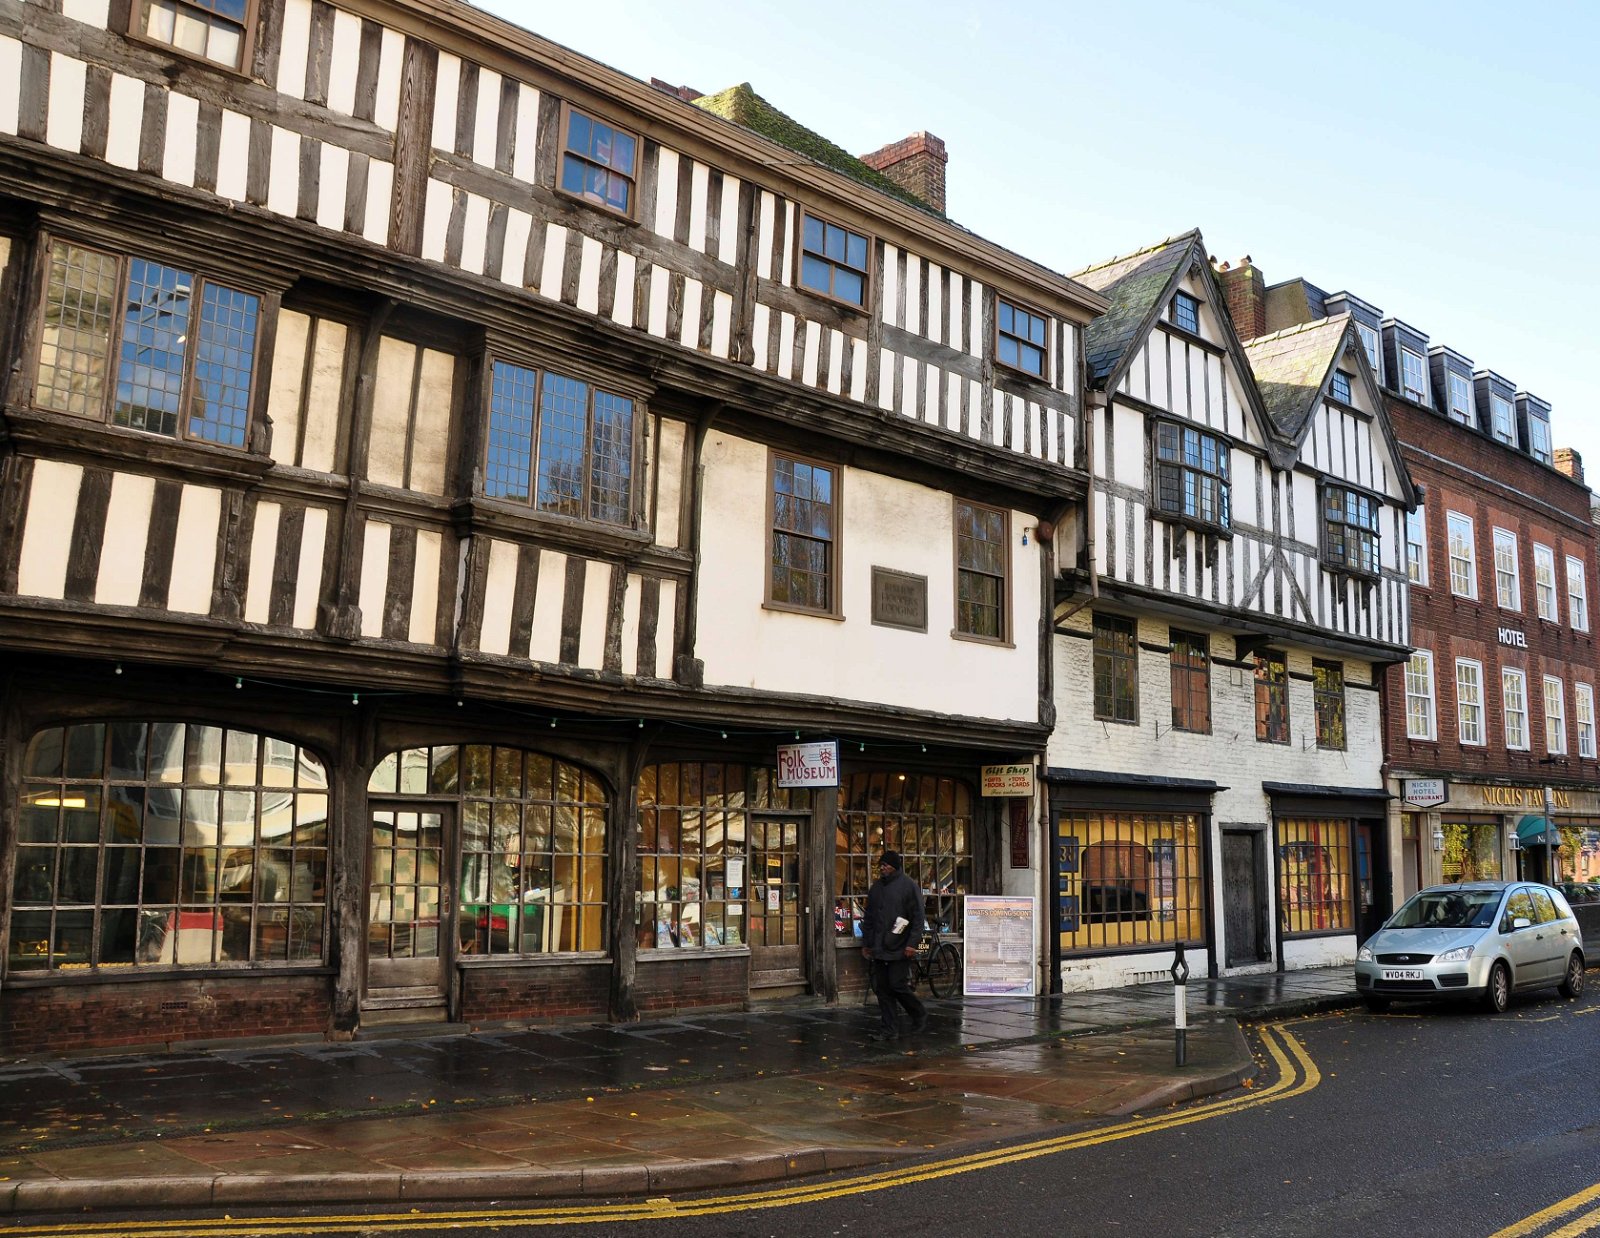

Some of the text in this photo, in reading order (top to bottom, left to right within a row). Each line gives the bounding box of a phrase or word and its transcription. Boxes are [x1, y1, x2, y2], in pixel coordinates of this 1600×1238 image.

[1498, 627, 1528, 648] HOTEL
[778, 749, 806, 780] Folk
[986, 766, 1029, 775] Gift Shop
[787, 767, 835, 780] MUSEUM
[1482, 787, 1523, 806] NICKIS
[1526, 789, 1570, 808] TAVRNA
[989, 909, 1012, 917] COMING
[1385, 971, 1421, 979] WV04 RKJ
